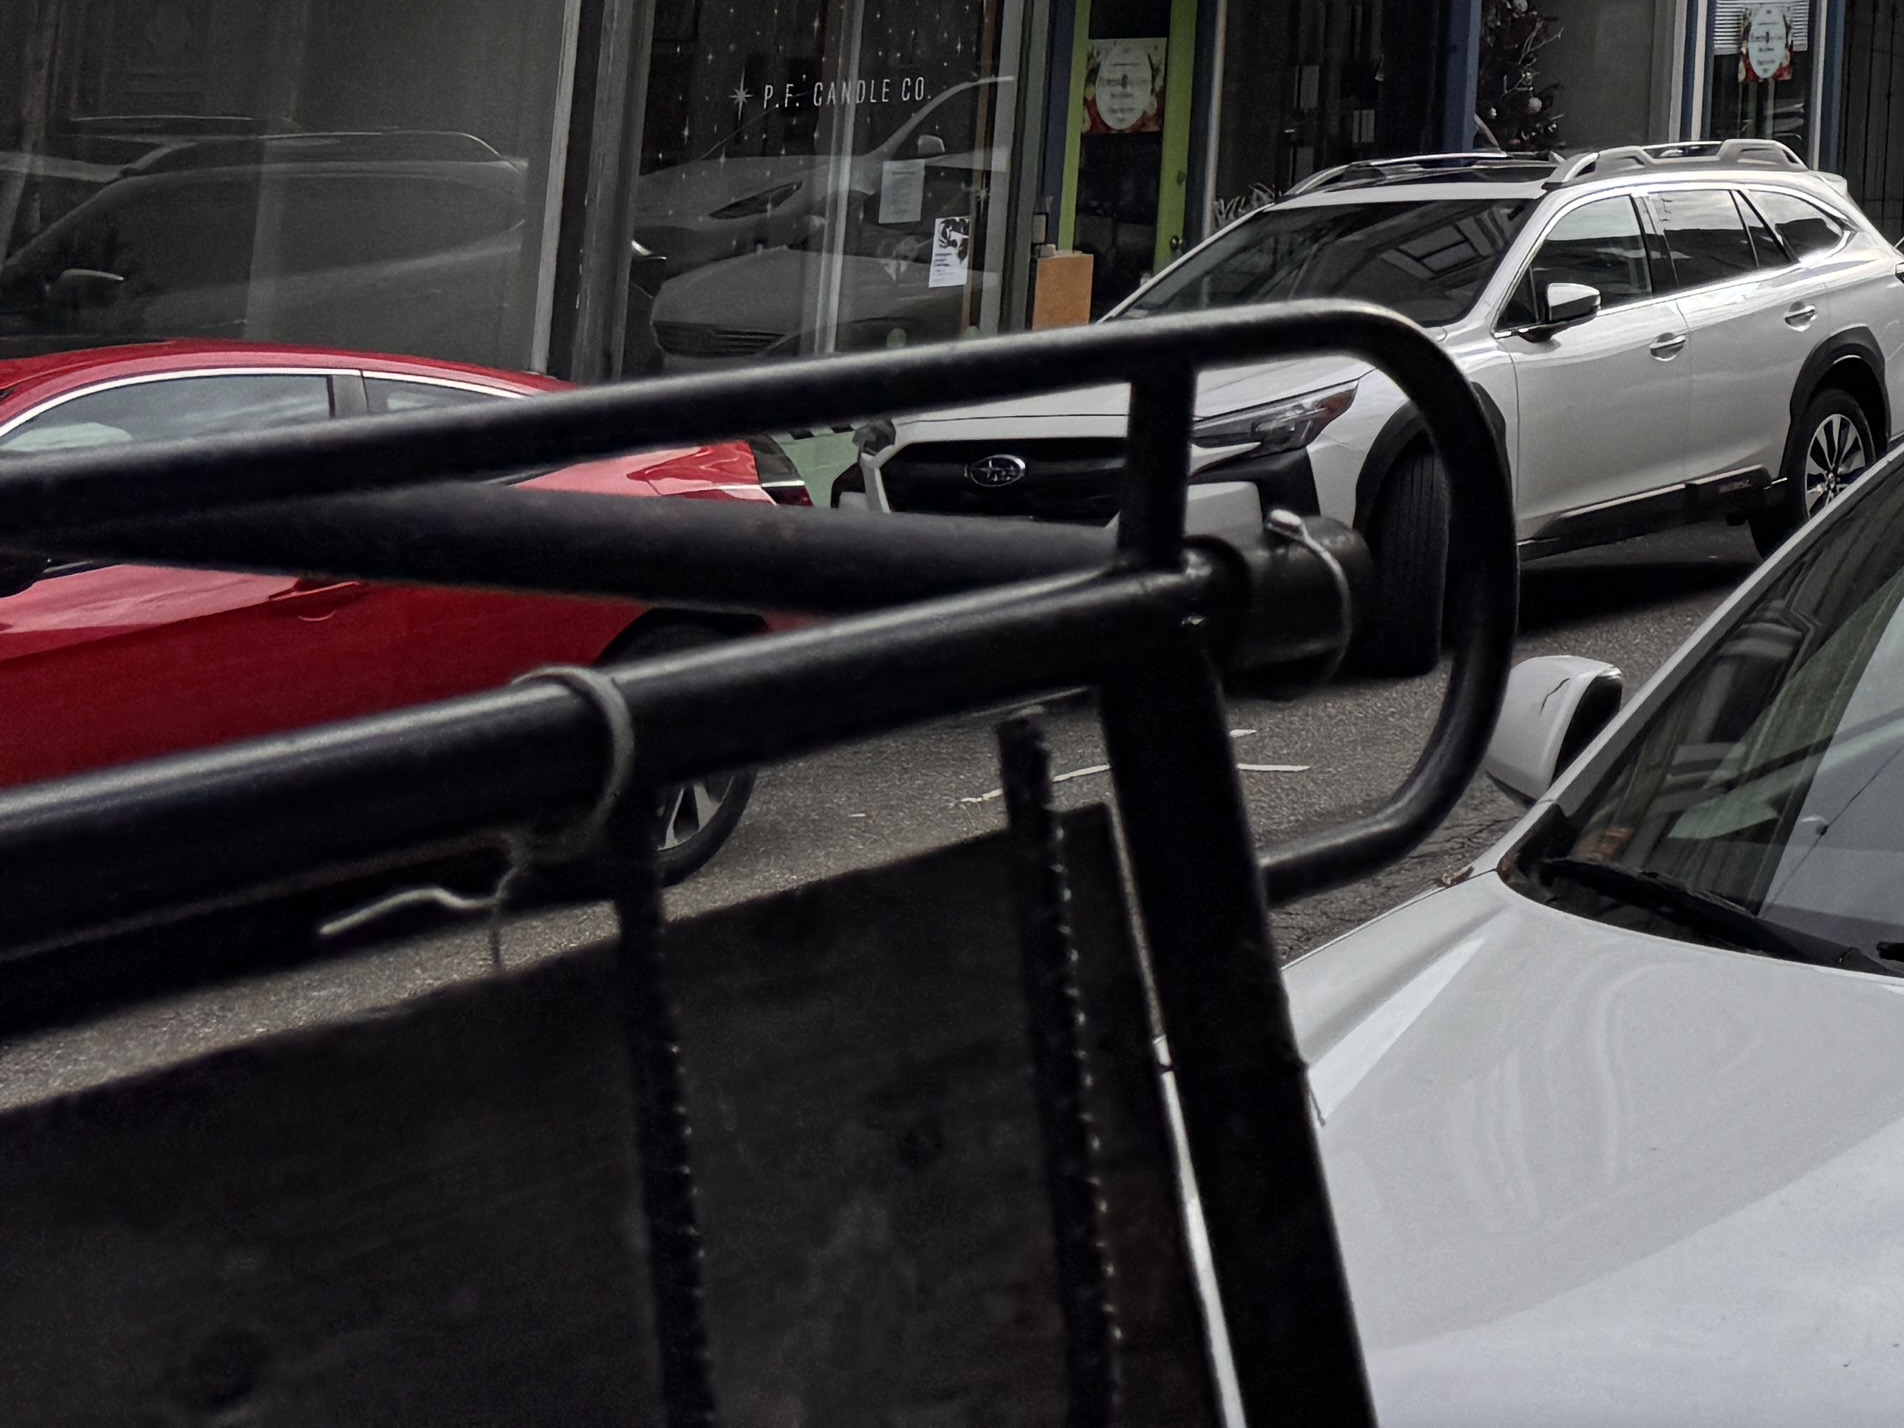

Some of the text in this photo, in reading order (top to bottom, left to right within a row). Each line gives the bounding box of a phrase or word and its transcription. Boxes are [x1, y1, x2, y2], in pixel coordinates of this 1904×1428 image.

[763, 75, 932, 110] P.F. CANDLE CO.
